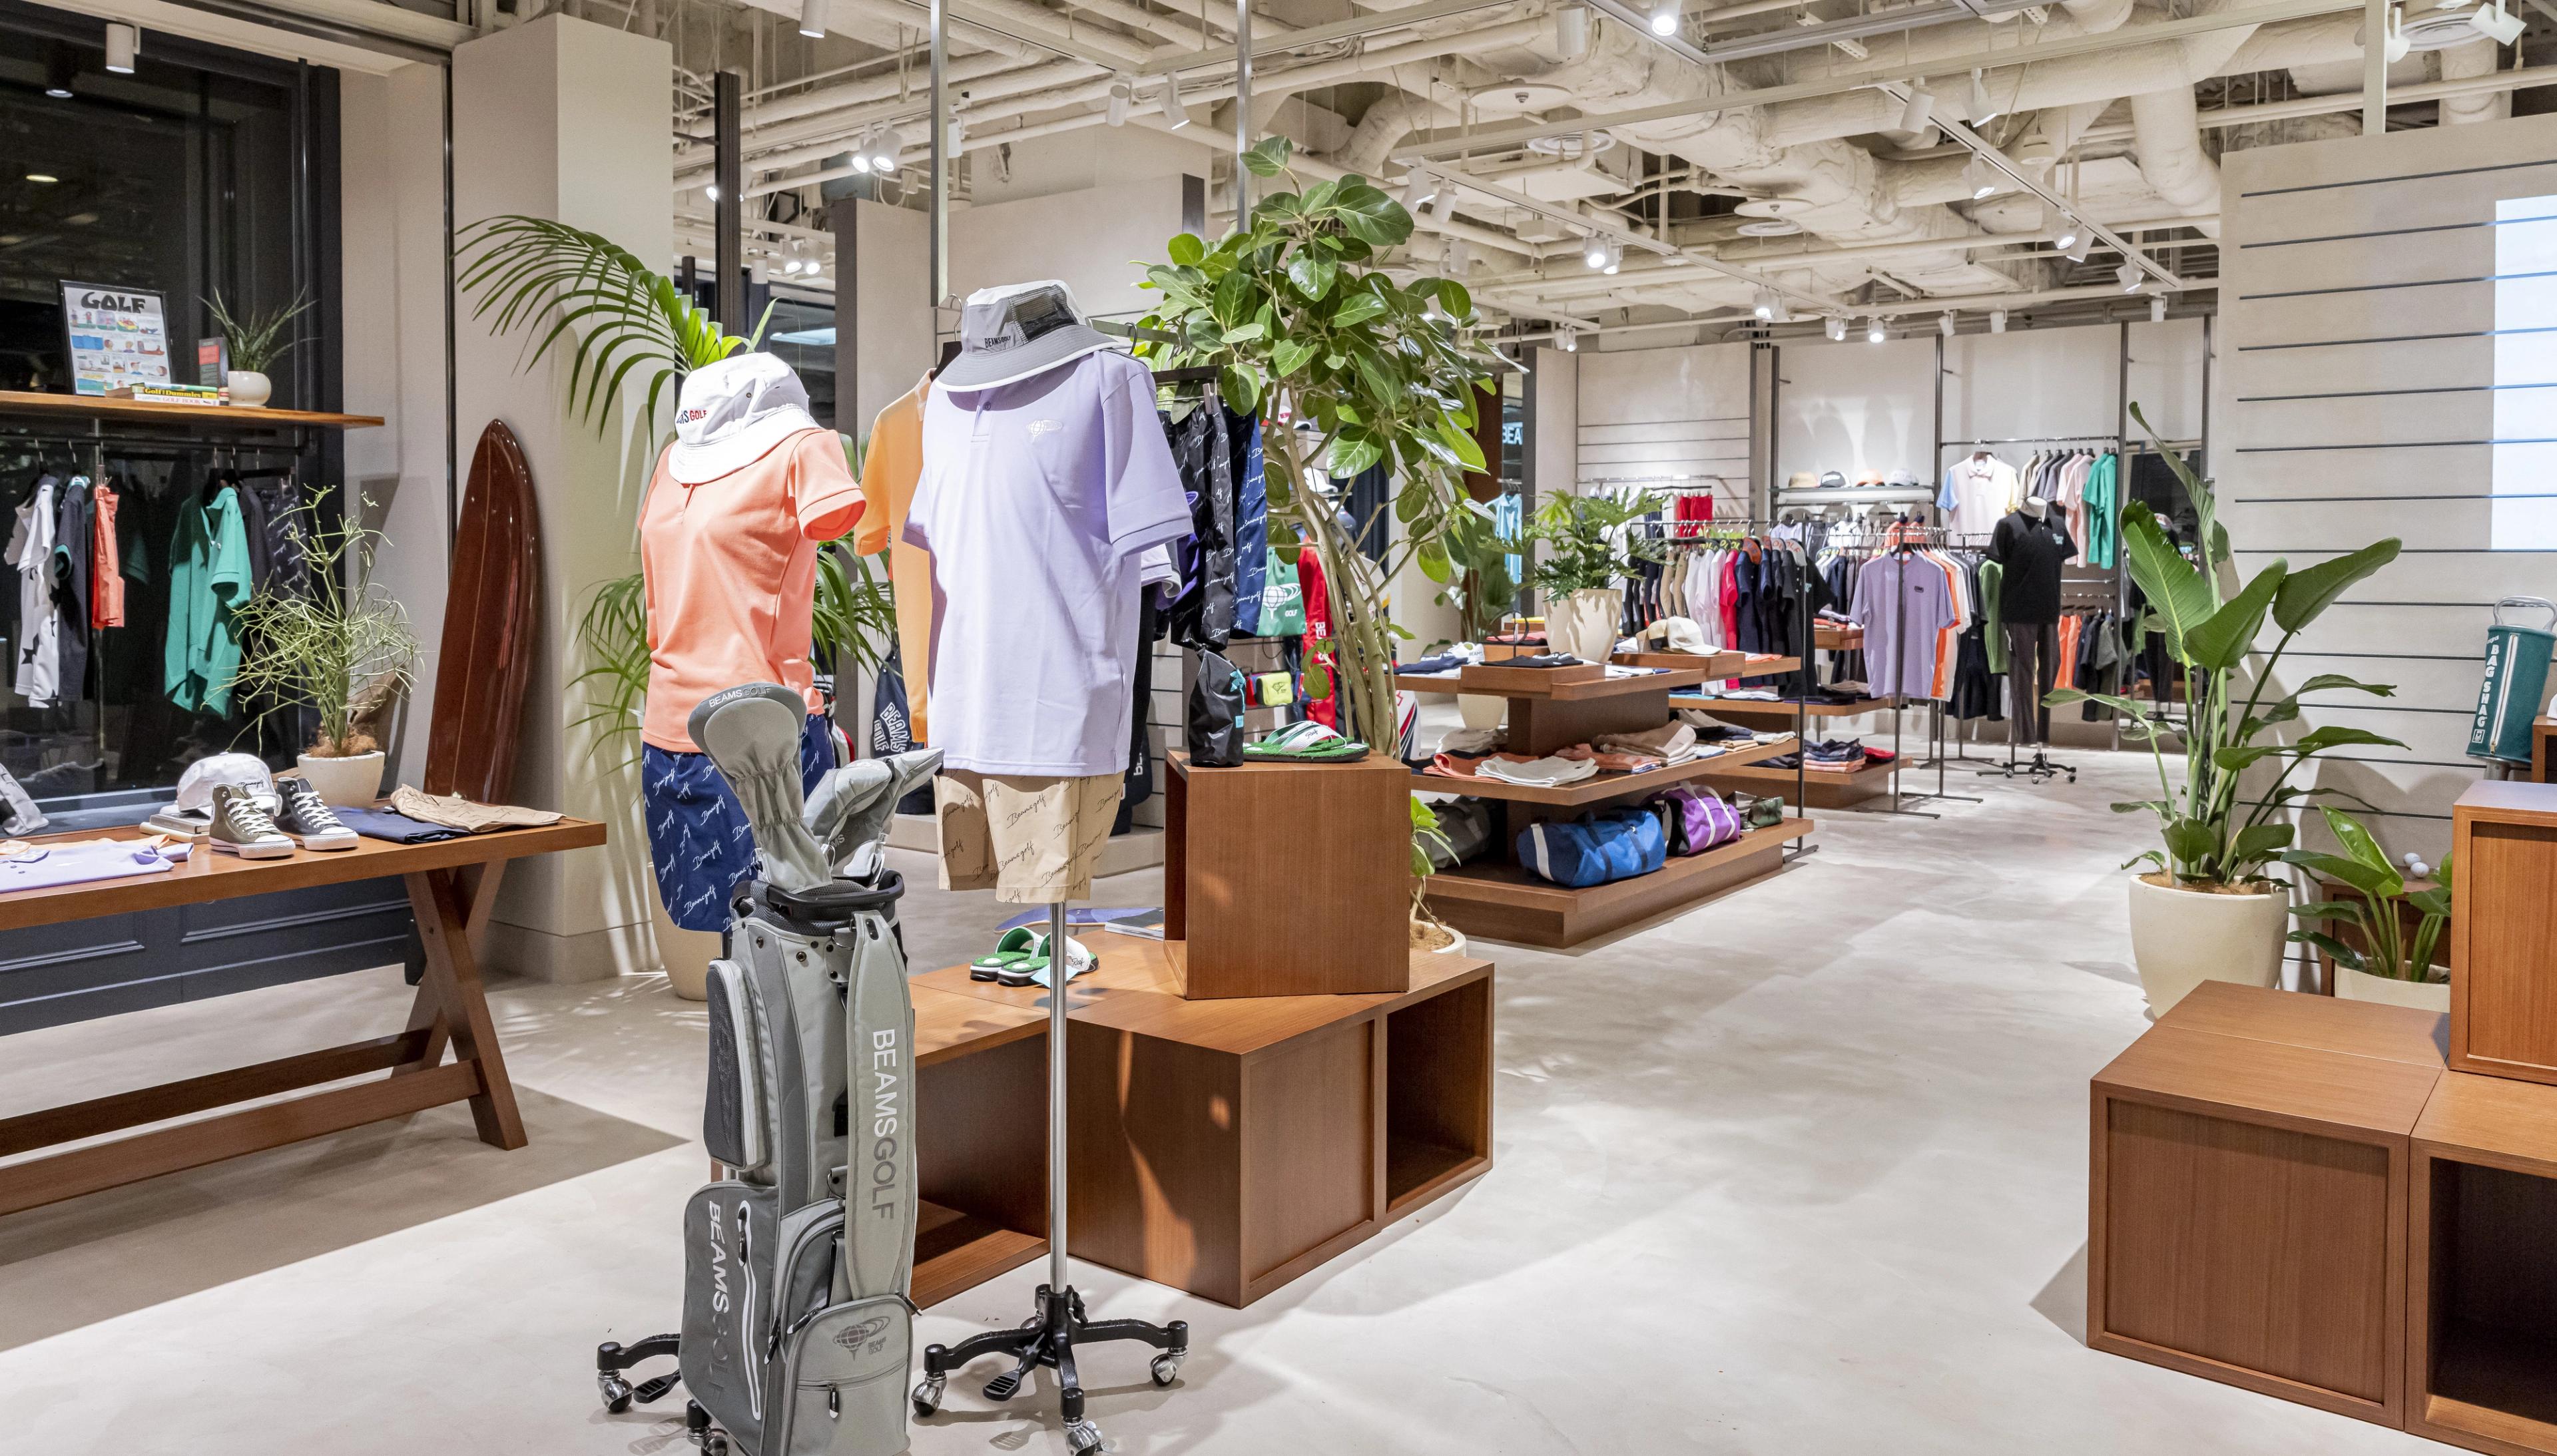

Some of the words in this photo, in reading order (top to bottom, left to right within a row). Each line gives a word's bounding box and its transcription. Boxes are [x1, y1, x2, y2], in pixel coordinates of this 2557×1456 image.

[81, 292, 146, 314] GOLF
[1502, 426, 1523, 445] BEA
[2485, 644, 2499, 678] BAG
[2477, 681, 2492, 728] SHAG
[874, 719, 890, 751] GOLF
[880, 702, 910, 753] BEAMS
[868, 1337, 887, 1347] BEAMS
[868, 1343, 884, 1355] GOLF
